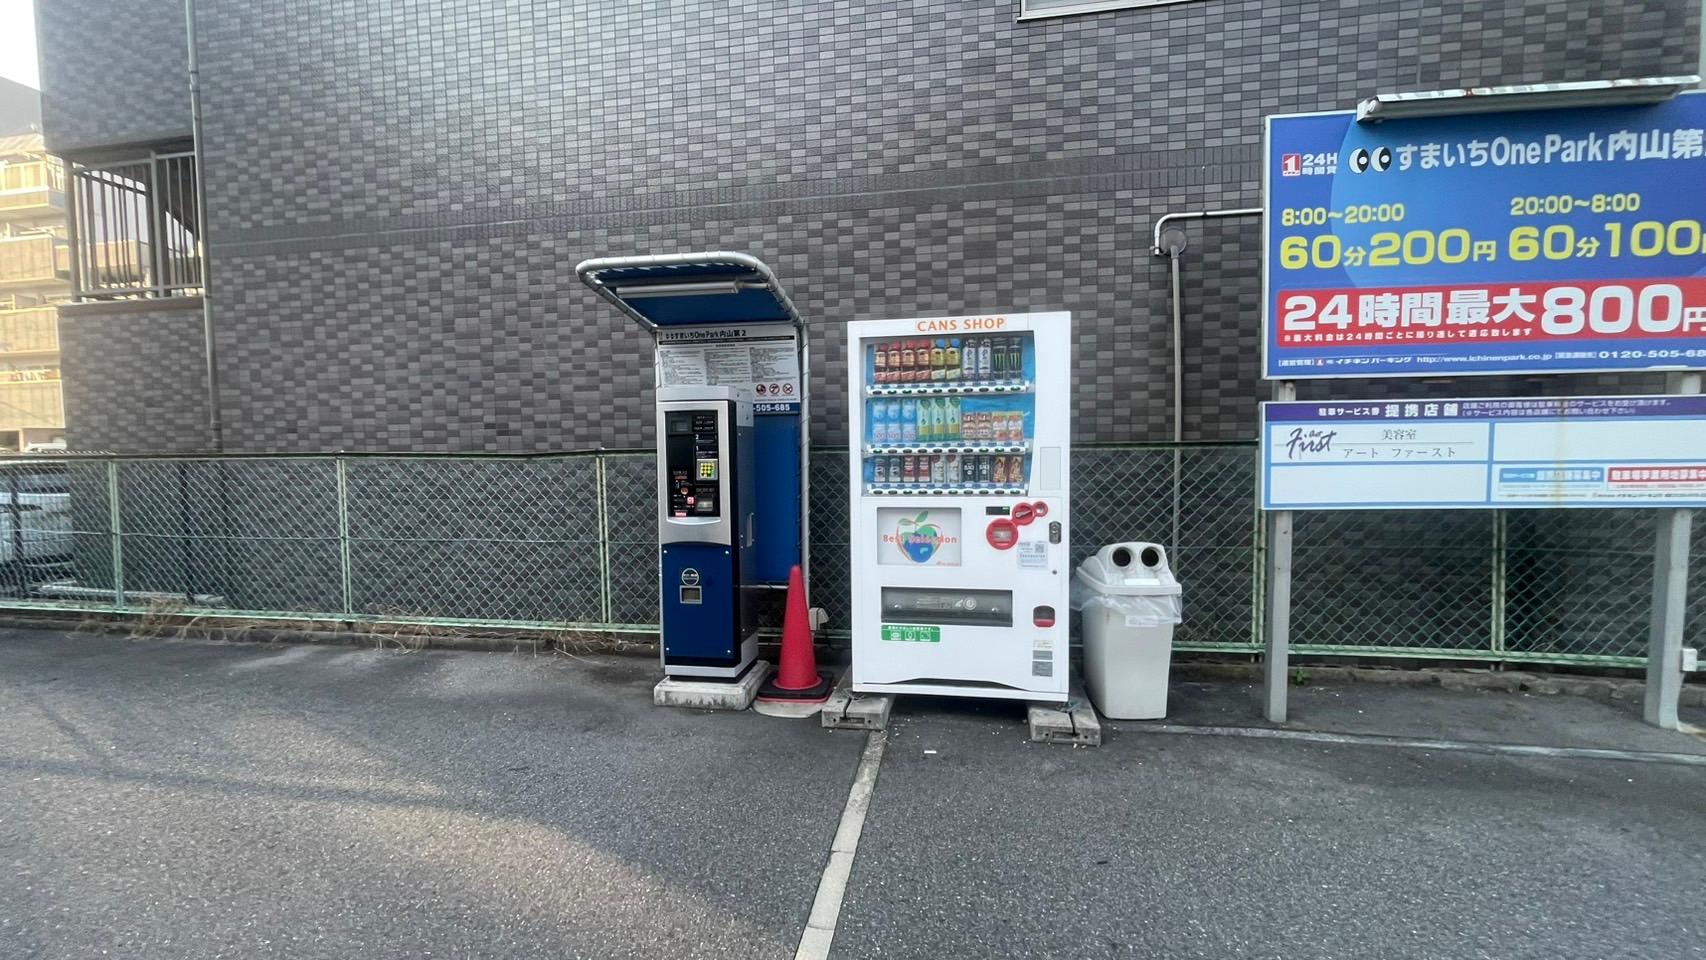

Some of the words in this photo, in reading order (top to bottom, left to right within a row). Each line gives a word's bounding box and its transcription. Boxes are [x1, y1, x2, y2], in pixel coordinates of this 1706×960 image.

[1396, 128, 1706, 170] すまいちOnePark内山第
[1302, 152, 1337, 166] 24H
[1508, 219, 1706, 261] 60分100
[1280, 228, 1497, 270] 60分200円
[917, 320, 957, 332] CANS
[963, 318, 1005, 330] SHOP
[1382, 428, 1417, 440] 美容室
[1343, 448, 1379, 458] アート
